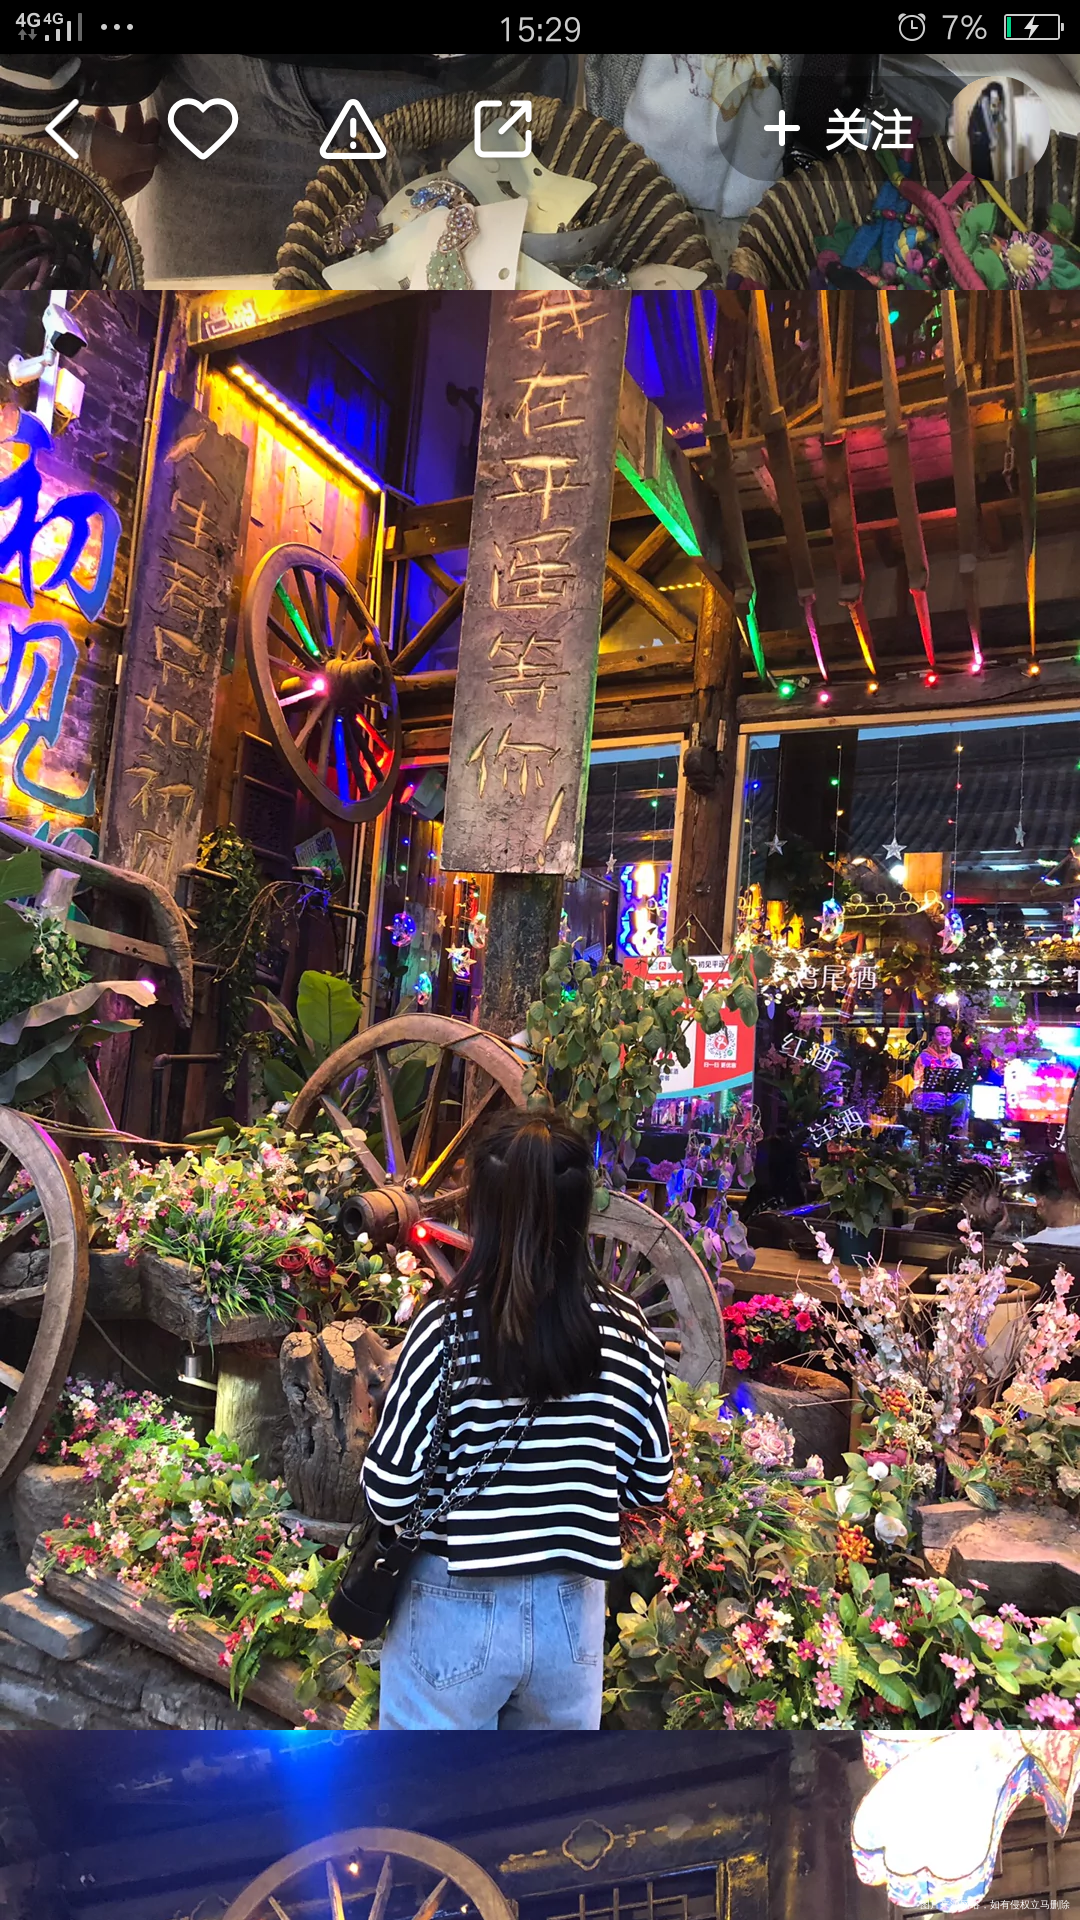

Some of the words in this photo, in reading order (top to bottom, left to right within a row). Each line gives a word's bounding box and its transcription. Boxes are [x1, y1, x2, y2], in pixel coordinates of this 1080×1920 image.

[0, 406, 123, 870] 初见
[794, 964, 877, 990] 鸡尾酒
[779, 1032, 837, 1072] 红酒
[807, 1105, 865, 1148] 洋酒
